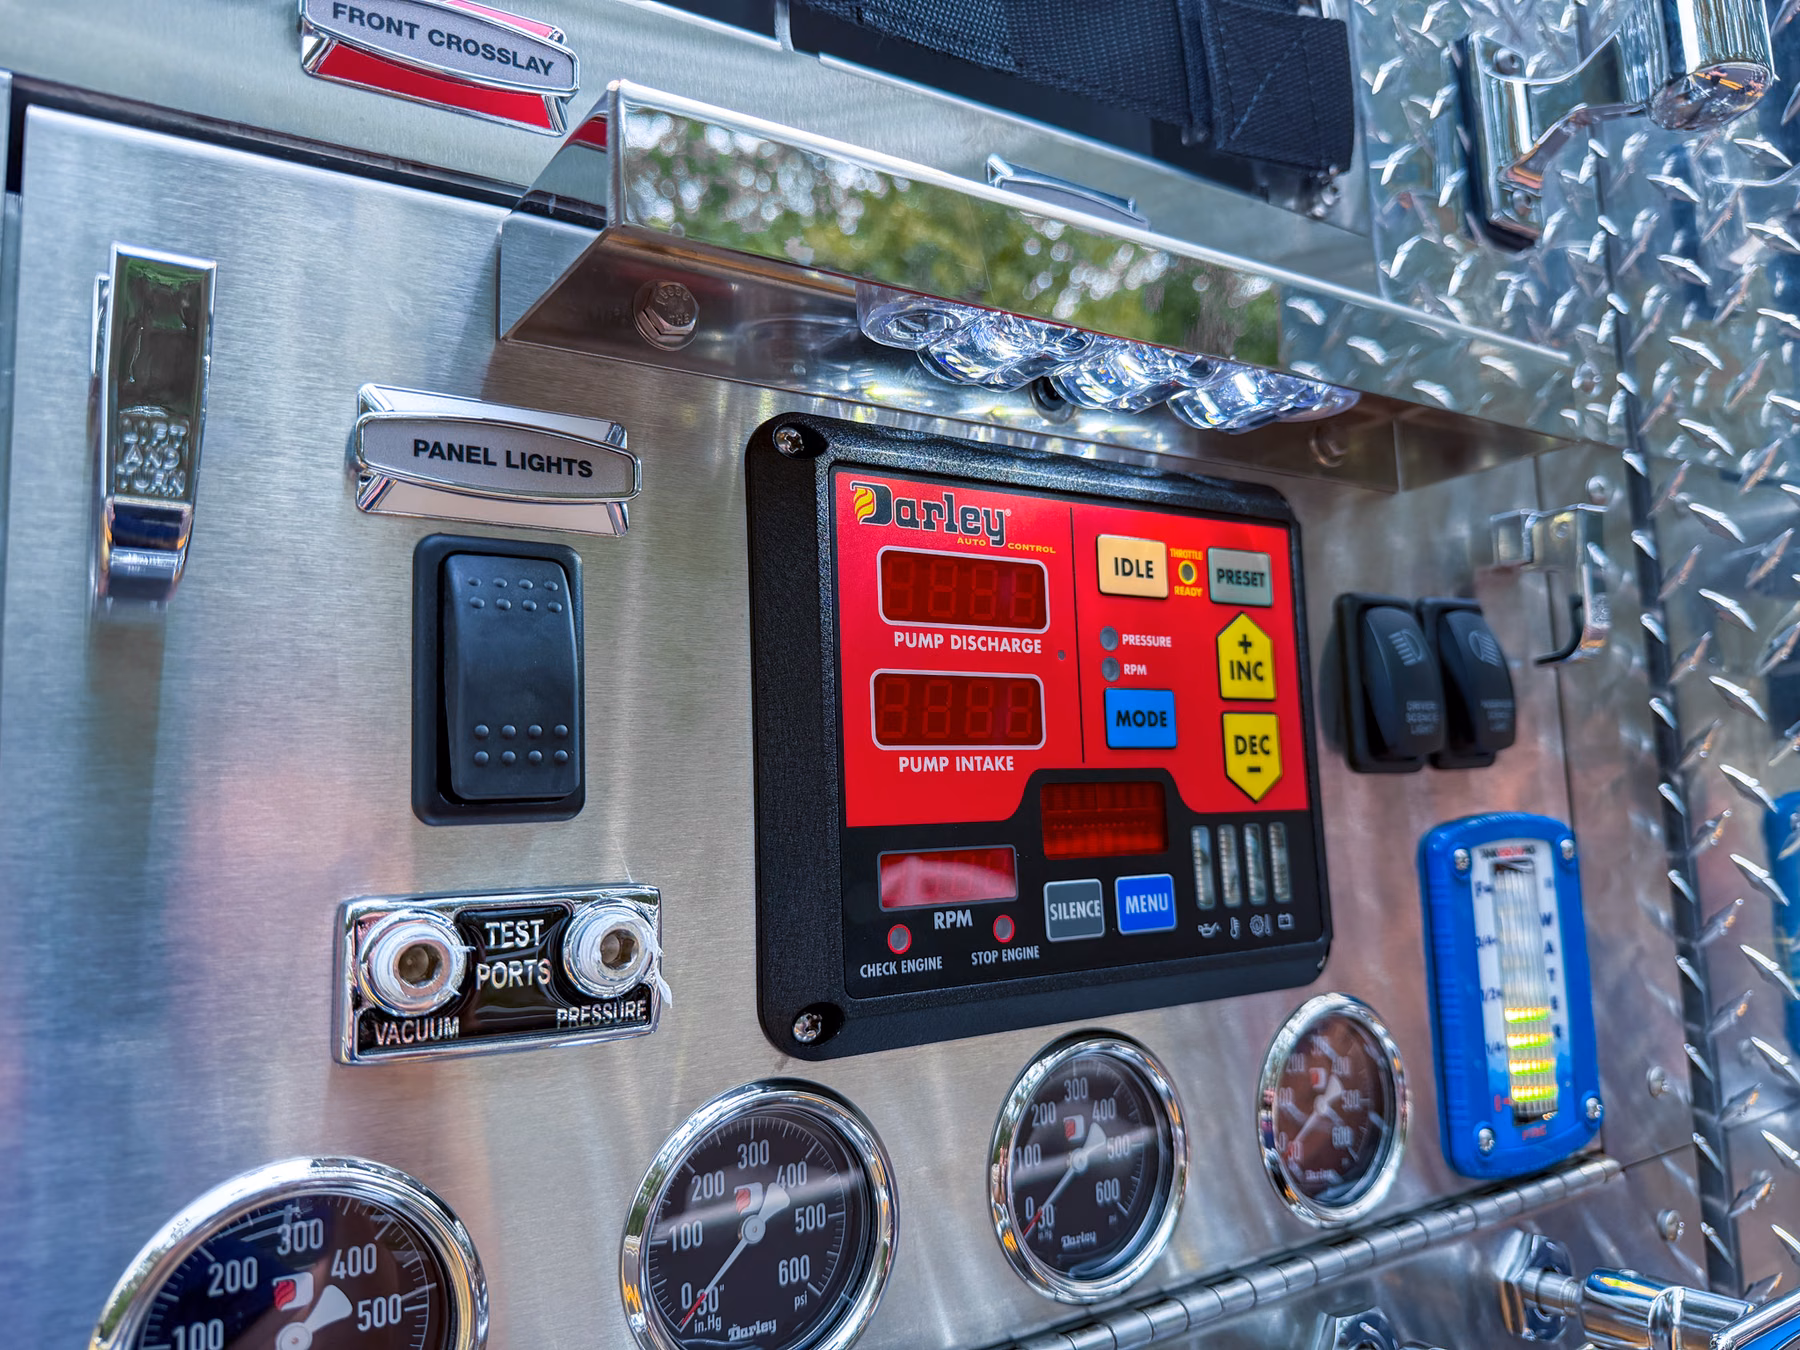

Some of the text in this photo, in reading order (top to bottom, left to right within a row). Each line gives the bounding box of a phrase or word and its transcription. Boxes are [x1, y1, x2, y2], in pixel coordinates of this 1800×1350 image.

[332, 2, 554, 77] FRONT CROSSLAY
[124, 444, 180, 468] AND
[413, 439, 593, 478] PANEL LIGHTS
[116, 464, 186, 496] TURN
[957, 537, 1056, 554] AUTO CONTROL
[1170, 548, 1203, 560] THROTTLE
[1114, 557, 1154, 579] IDLE
[1217, 568, 1265, 588] PRESET
[1174, 586, 1202, 597] READY
[894, 631, 1042, 654] PUMP DISCHARGE
[1122, 634, 1172, 648] PRESSURE
[1123, 664, 1147, 675] RPM
[1229, 660, 1264, 681] INC
[1116, 710, 1167, 727] MODE
[1234, 735, 1270, 755] DEC
[899, 756, 1014, 772] PUMP INTAKE
[1050, 900, 1101, 921] SILENCE
[1125, 893, 1169, 914] MENU
[933, 910, 973, 930] RPM
[485, 919, 544, 949] TEST
[859, 956, 943, 978] CHECK ENGINE
[971, 946, 1040, 966] STOP ENGINE
[476, 958, 551, 990] PORTS
[375, 1000, 647, 1046] VACUUM PRESSURE
[1286, 1053, 1305, 1073] 200
[1064, 1077, 1088, 1101] 300
[1341, 1088, 1361, 1110] 500
[1031, 1102, 1056, 1128] 200
[1092, 1097, 1116, 1121] 400
[1107, 1135, 1130, 1158] 500
[1332, 1126, 1353, 1147] 600
[737, 1139, 769, 1170] 300
[1016, 1143, 1041, 1168] 100
[692, 1171, 725, 1202] 200
[776, 1161, 808, 1189] 400
[1096, 1177, 1120, 1204] 600
[795, 1203, 826, 1233] 500
[1025, 1196, 1034, 1220] 0
[276, 1218, 324, 1255] 300
[669, 1220, 703, 1252] 100
[1061, 1231, 1096, 1249] Darley
[331, 1243, 377, 1280] 400
[778, 1254, 810, 1286] 600
[207, 1256, 258, 1296] 200
[681, 1282, 692, 1310] 0
[794, 1291, 808, 1310] psi
[357, 1293, 402, 1332] 500
[694, 1313, 722, 1333] in.Hg
[172, 1318, 224, 1350] 100
[728, 1319, 777, 1342] Darley
